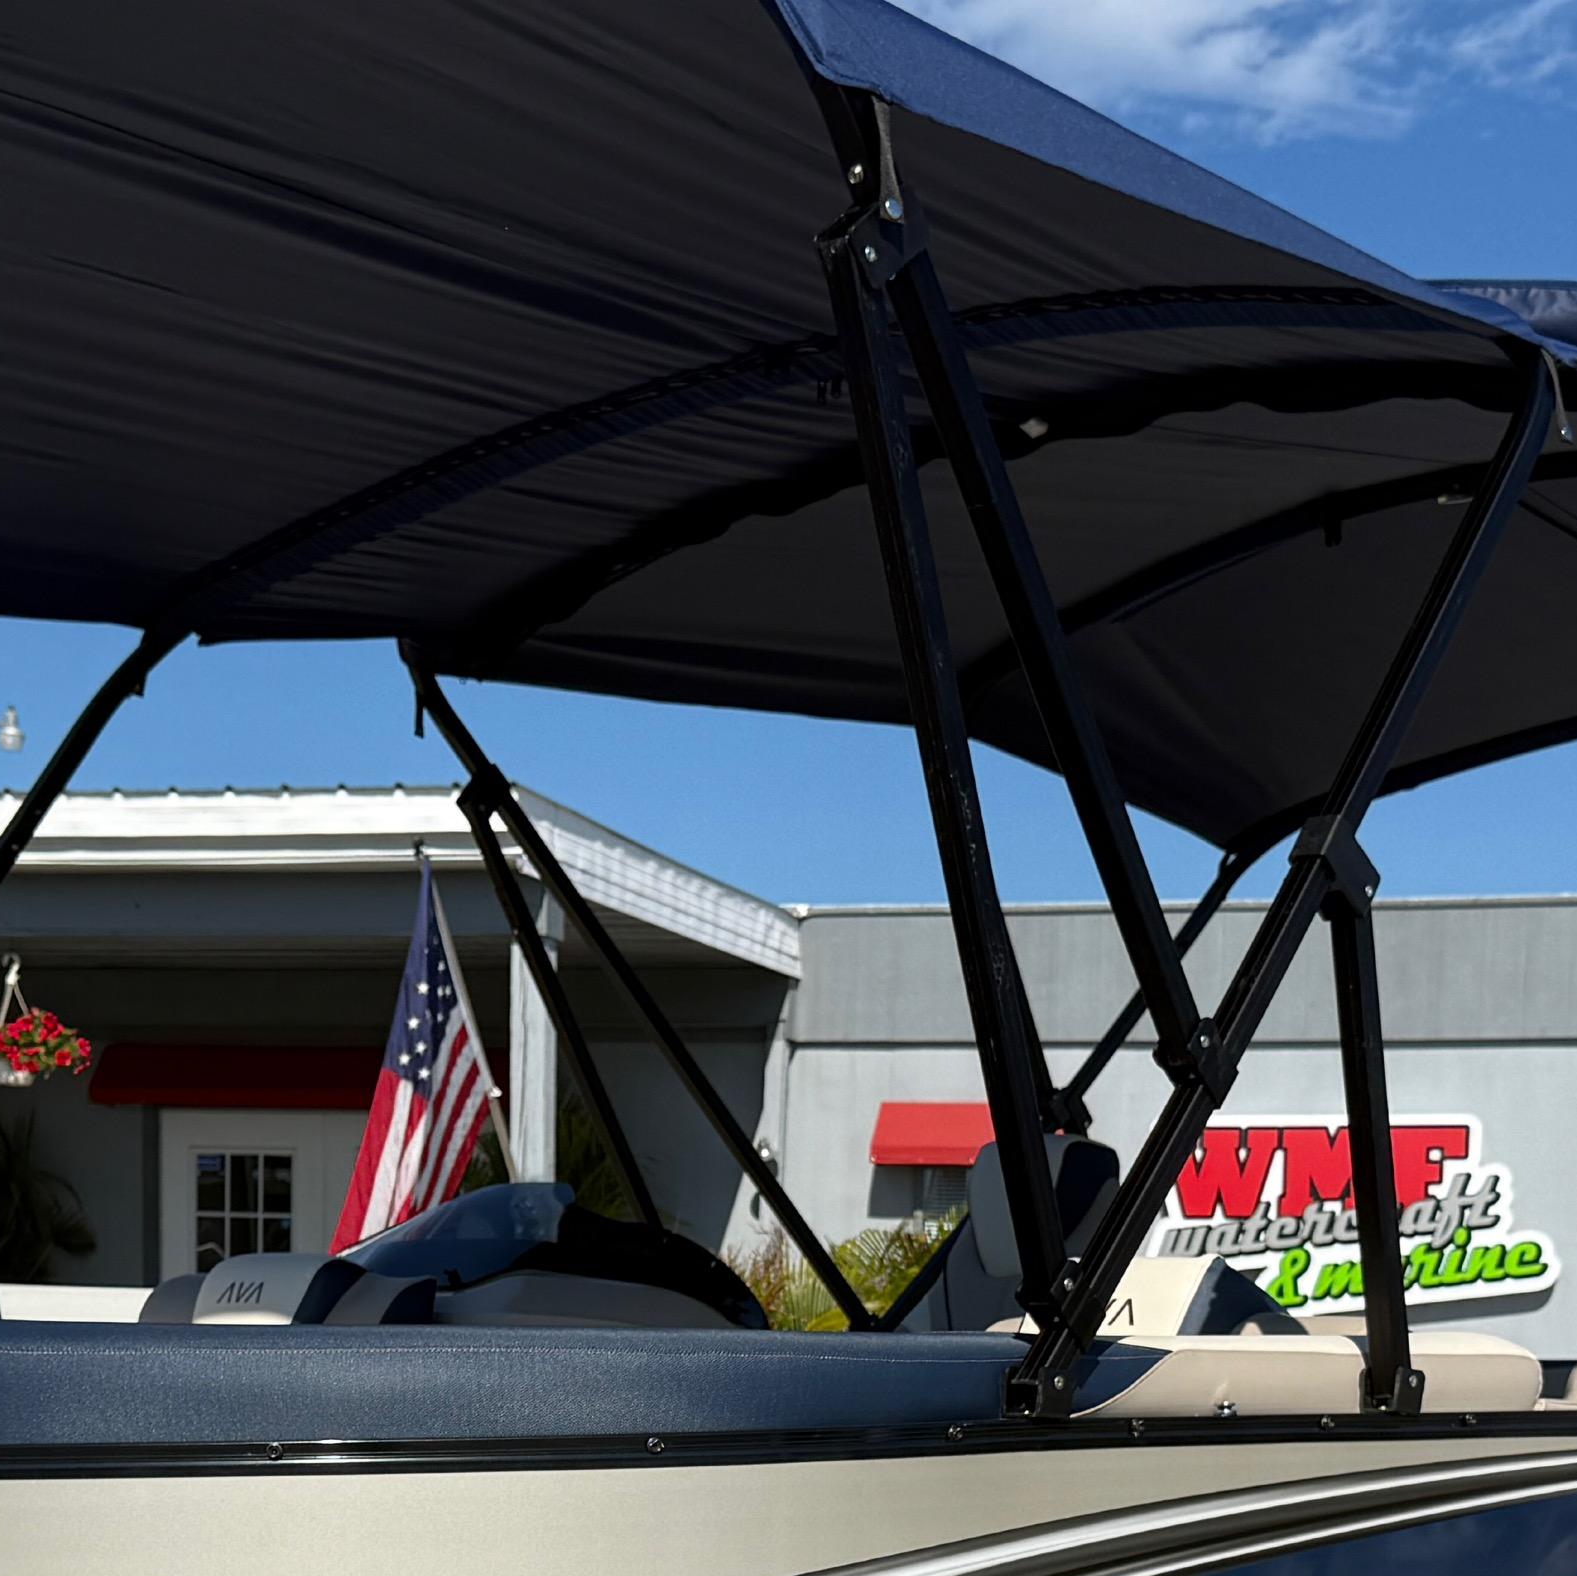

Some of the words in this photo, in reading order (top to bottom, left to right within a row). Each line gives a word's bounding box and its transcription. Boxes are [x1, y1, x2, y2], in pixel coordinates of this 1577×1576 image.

[1175, 1125, 1469, 1219] WMF
[1159, 1173, 1501, 1258] watercaft
[216, 1281, 264, 1304] AVA
[1312, 1227, 1547, 1300] mrine
